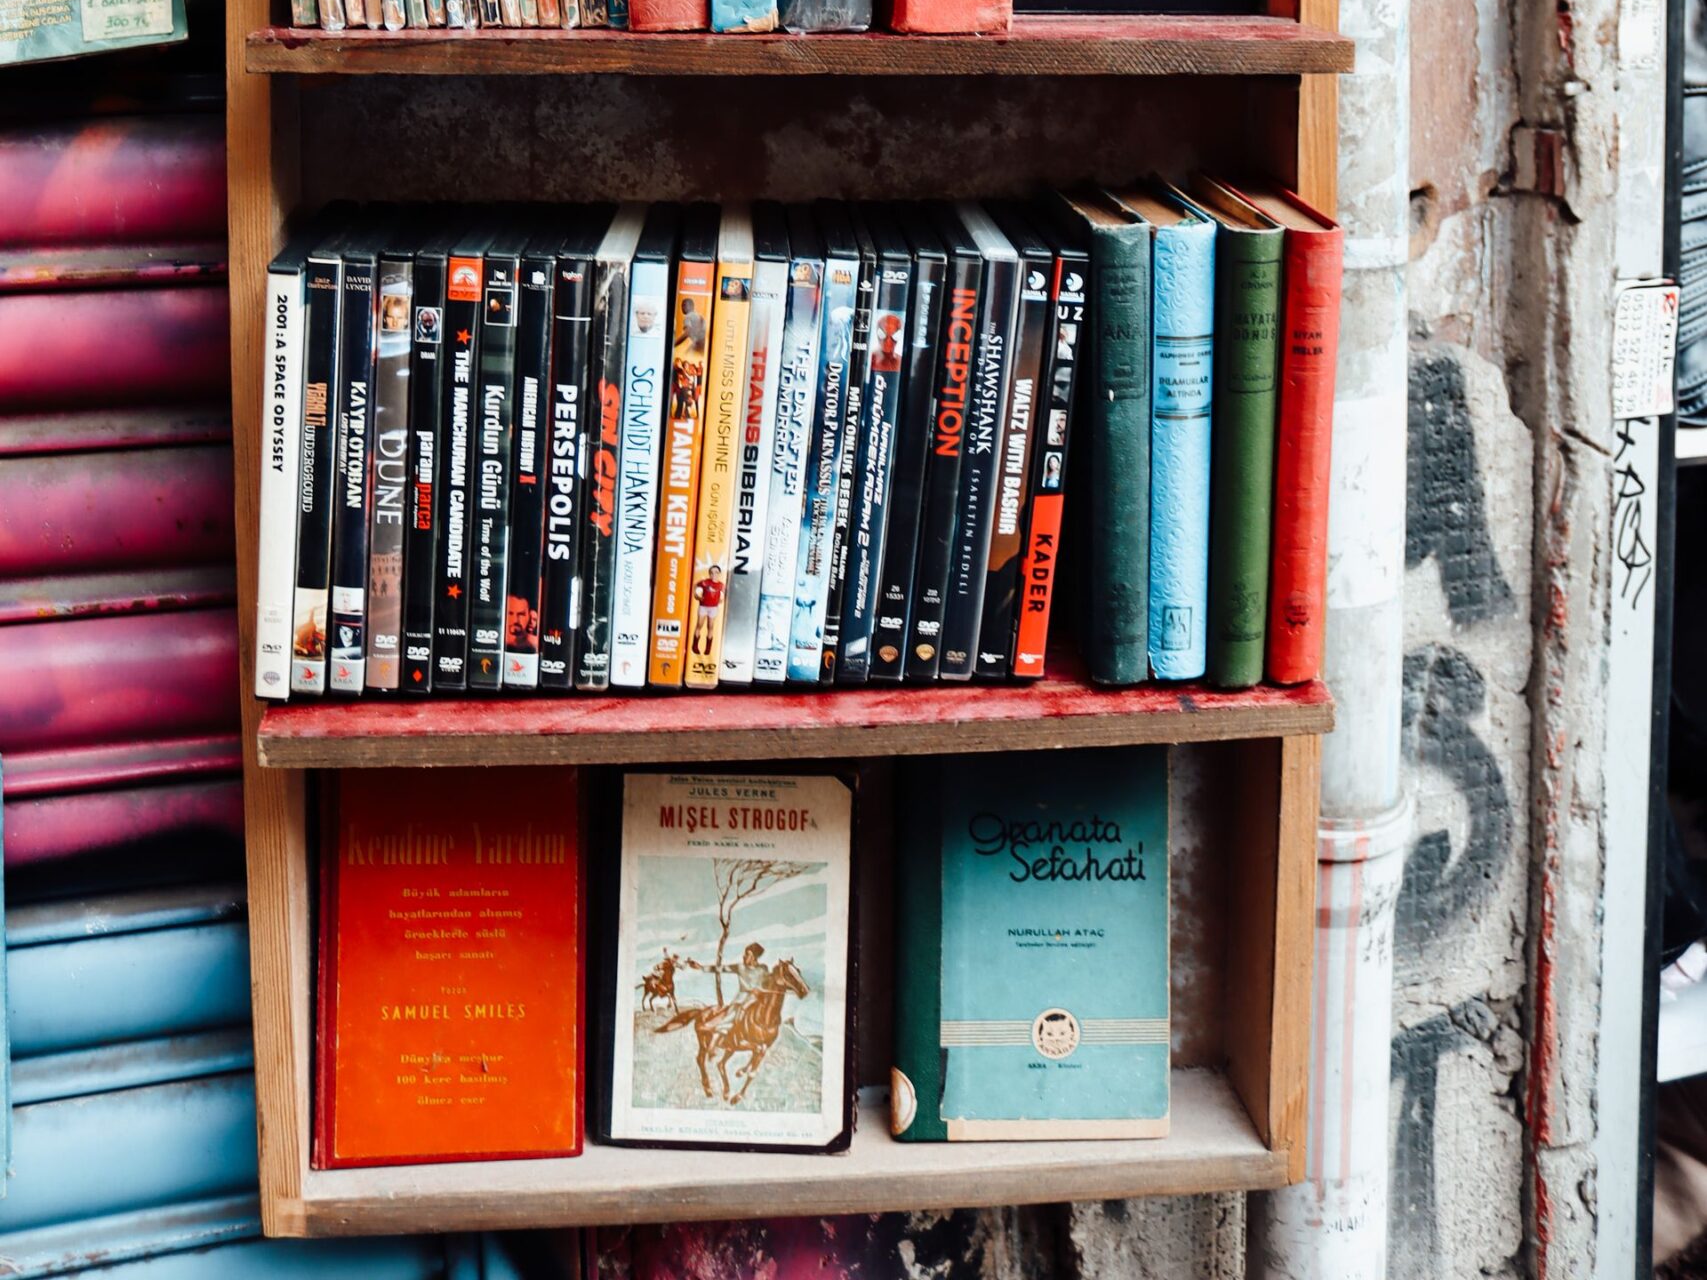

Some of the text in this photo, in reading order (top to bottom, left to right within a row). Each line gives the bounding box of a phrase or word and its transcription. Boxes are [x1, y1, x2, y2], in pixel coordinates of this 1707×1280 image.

[345, 284, 372, 293] LYNCH
[346, 275, 372, 284] DAVID
[882, 270, 908, 284] DVD
[988, 321, 997, 335] THE
[274, 354, 287, 400] SPACE
[721, 353, 736, 387] MISS
[823, 361, 844, 418] DOKTOR
[935, 287, 977, 457] INCEPTION
[968, 332, 989, 455] REDEMPTION
[976, 333, 1004, 455] SHAWSHANK
[272, 405, 285, 473] ODYSSEY
[519, 376, 538, 485] AMERICAN HISTORY X
[714, 390, 734, 473] SUNSHINE
[773, 360, 796, 475] TOMORROW
[784, 341, 812, 496] THE DAY AFTER
[347, 381, 367, 509] KAYIP OTOBAN
[447, 349, 471, 579] THE MANCHURIAN CANDIDATE
[734, 346, 768, 576] TRANSSIBERIAN
[816, 420, 842, 495] PARNASSUS
[998, 378, 1033, 535] WALTZ WITH BASHIR
[302, 425, 317, 513] UNDERGROUND
[376, 432, 406, 525] DUNE
[547, 383, 579, 561] PERSEPOLIS
[479, 384, 506, 603] Kurdun Günü Time of the Wolf
[623, 459, 650, 556] HAKKINDA
[664, 418, 695, 614] TANRI KENT CITY OF GOD
[836, 478, 852, 528] BEBEK
[858, 529, 871, 548] 2
[957, 545, 973, 595] BEDELİ
[1027, 532, 1053, 613] KADER
[375, 634, 398, 648] DVD
[475, 629, 499, 644] DVD
[656, 624, 680, 634] FILM
[879, 616, 904, 629] DVD
[918, 620, 941, 631] DVD
[406, 646, 430, 661] DVD
[439, 657, 463, 667] DVD
[540, 659, 566, 674] DVD
[688, 786, 777, 799] JULES VERNE
[728, 807, 810, 832] STROGOF
[968, 812, 1123, 856] Granata
[1009, 841, 1147, 883] Sefahati
[402, 887, 441, 899] Büyük
[1007, 927, 1105, 939] NURULLAH ATAÇ
[381, 1003, 526, 1021] SAMUEL SMILES
[396, 1075, 417, 1086] 100
[423, 1074, 452, 1086] kere
[460, 1095, 486, 1106] eser
